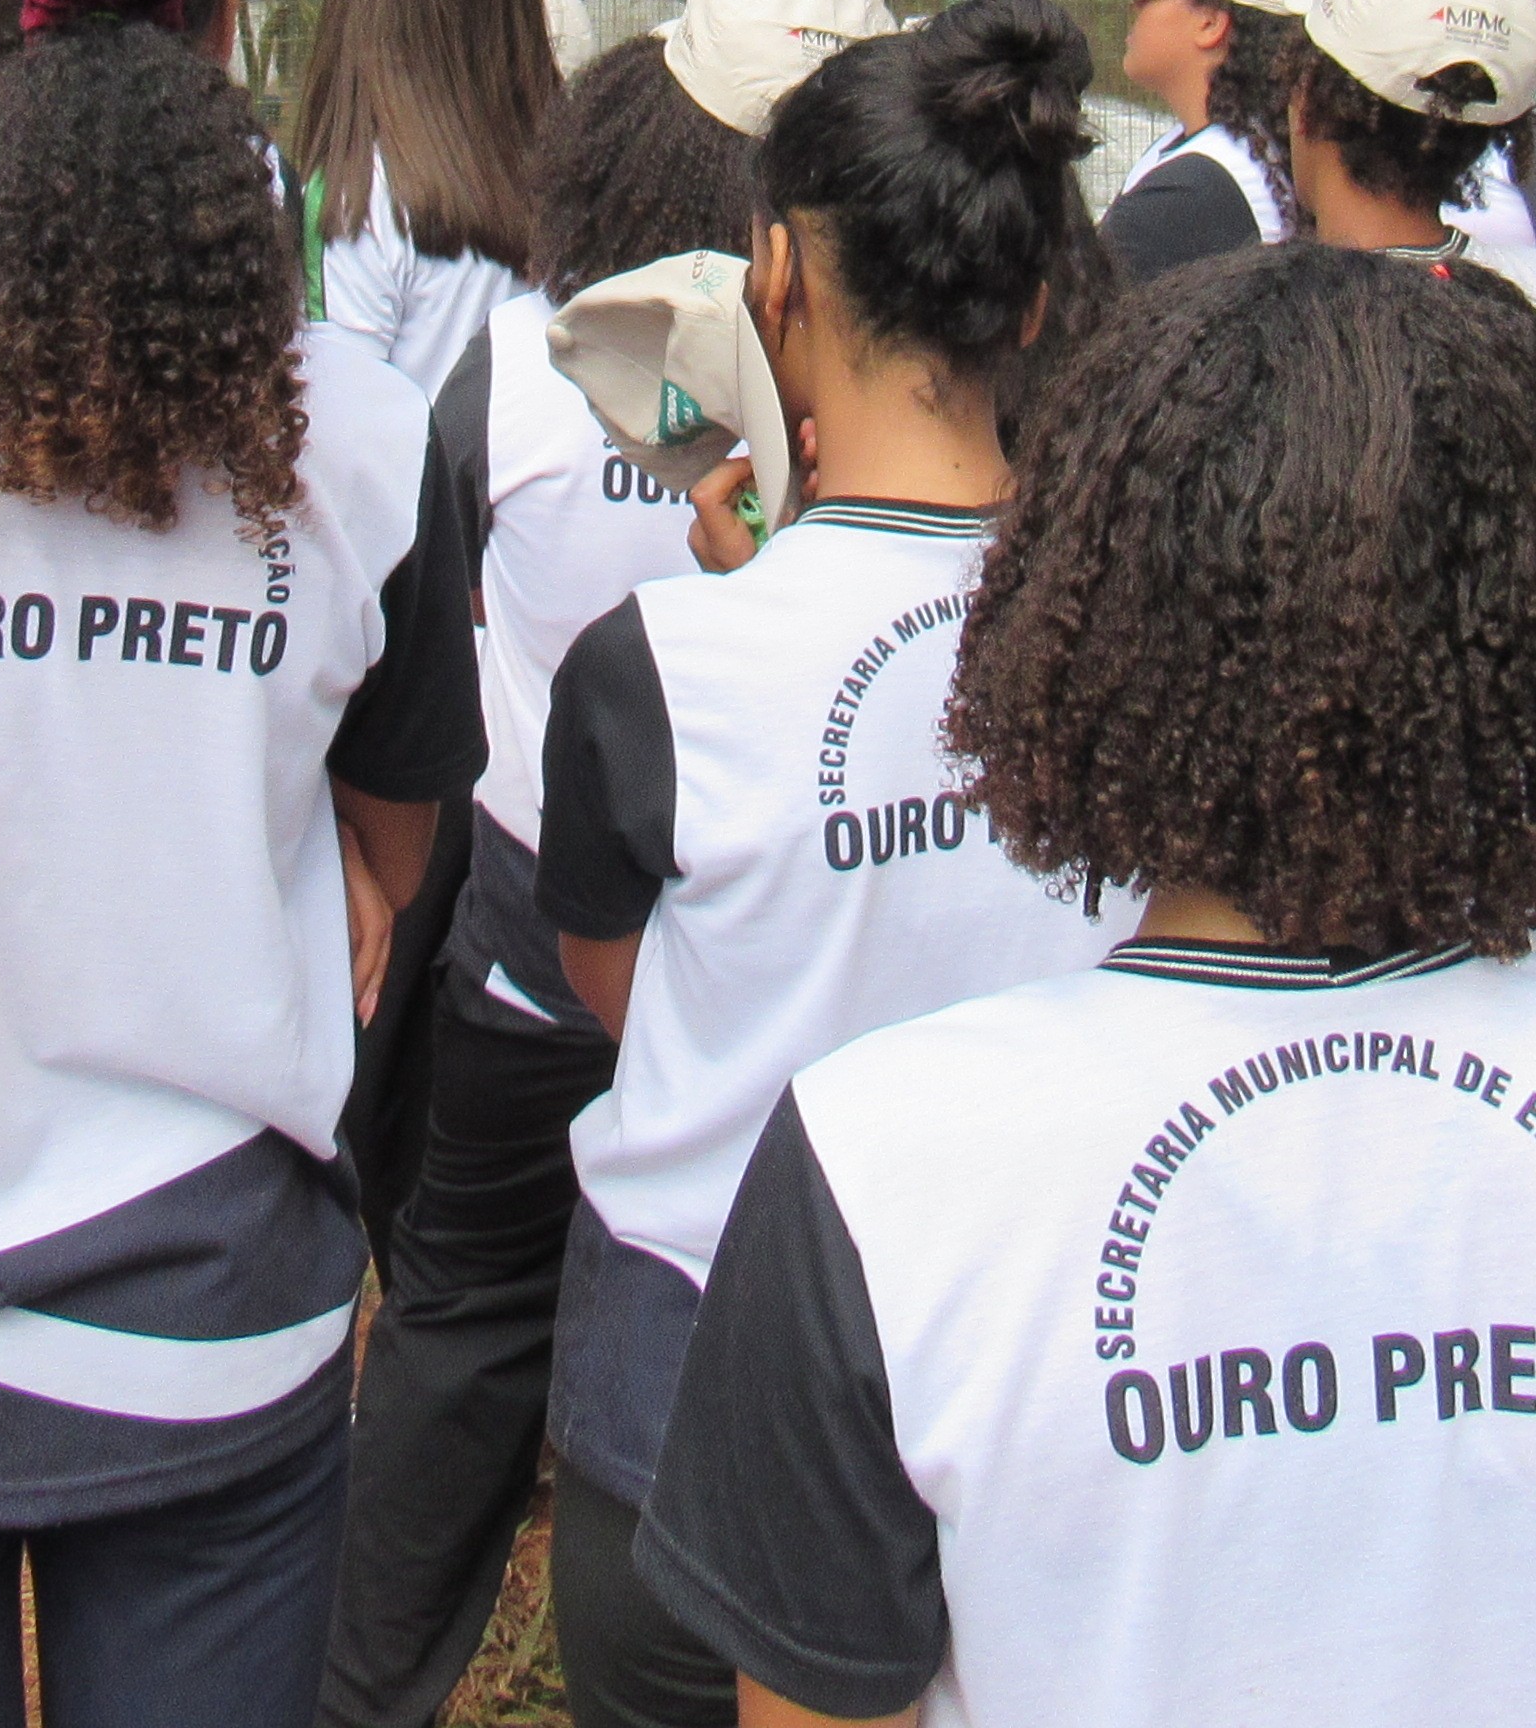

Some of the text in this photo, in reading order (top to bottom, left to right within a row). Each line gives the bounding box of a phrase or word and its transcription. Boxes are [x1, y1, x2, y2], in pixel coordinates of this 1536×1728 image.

[77, 596, 288, 677] PRETO
[819, 636, 897, 807] SECRETARIA
[824, 791, 965, 873] OURO
[1095, 1103, 1217, 1361] SECRETARIA
[1207, 1031, 1440, 1116] MUNICIPAL
[1453, 1051, 1514, 1108] DE
[1105, 1341, 1339, 1465] OURO
